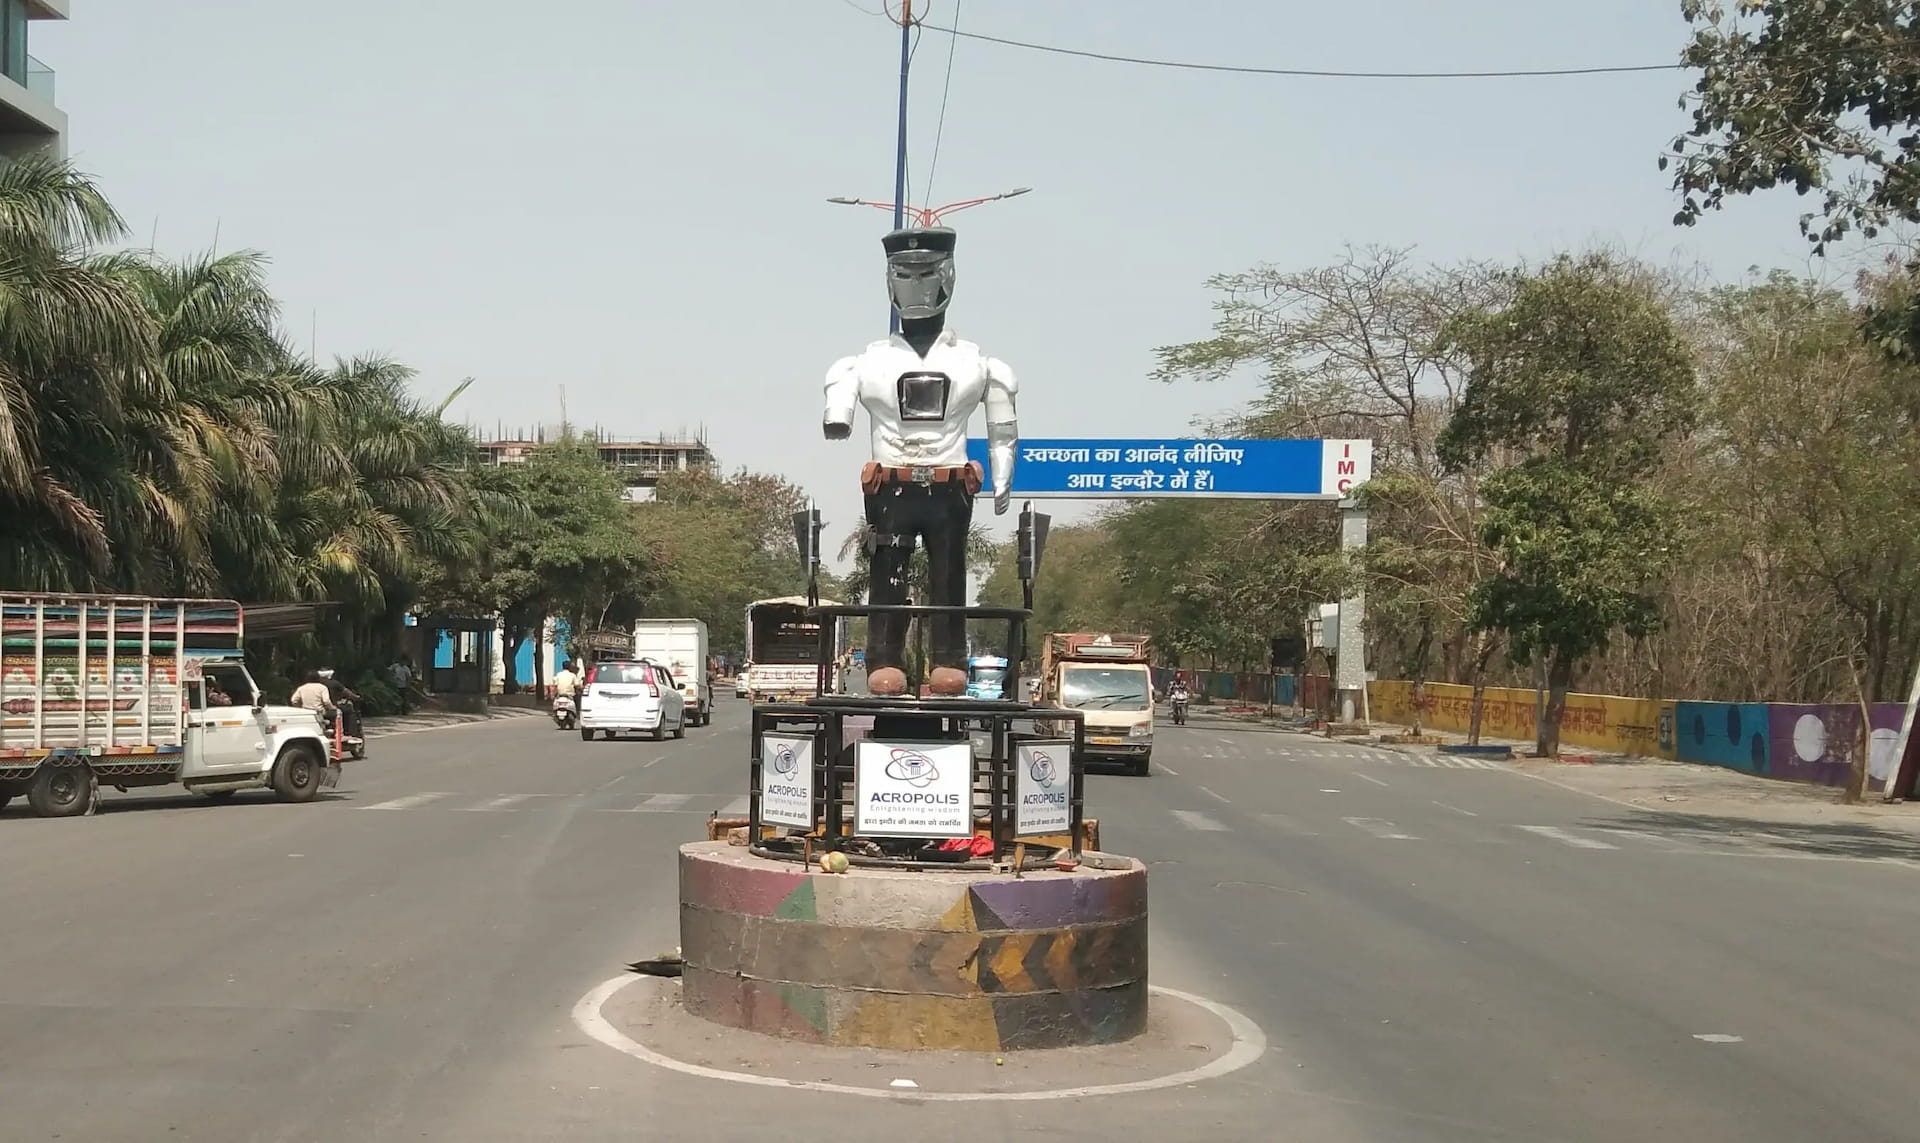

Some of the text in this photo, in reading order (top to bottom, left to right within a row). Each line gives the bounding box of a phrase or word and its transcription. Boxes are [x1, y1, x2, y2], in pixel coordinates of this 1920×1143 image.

[1023, 443, 1244, 465] स्वच्छता का आनंद लीजिए
[1068, 473, 1106, 488] आप
[1110, 469, 1164, 489] इन्दौर
[1170, 468, 1190, 488] में
[768, 784, 808, 798] ACROPOLIS
[870, 792, 960, 804] ACROPOLIS
[1023, 792, 1065, 805] ACROPOLIS
